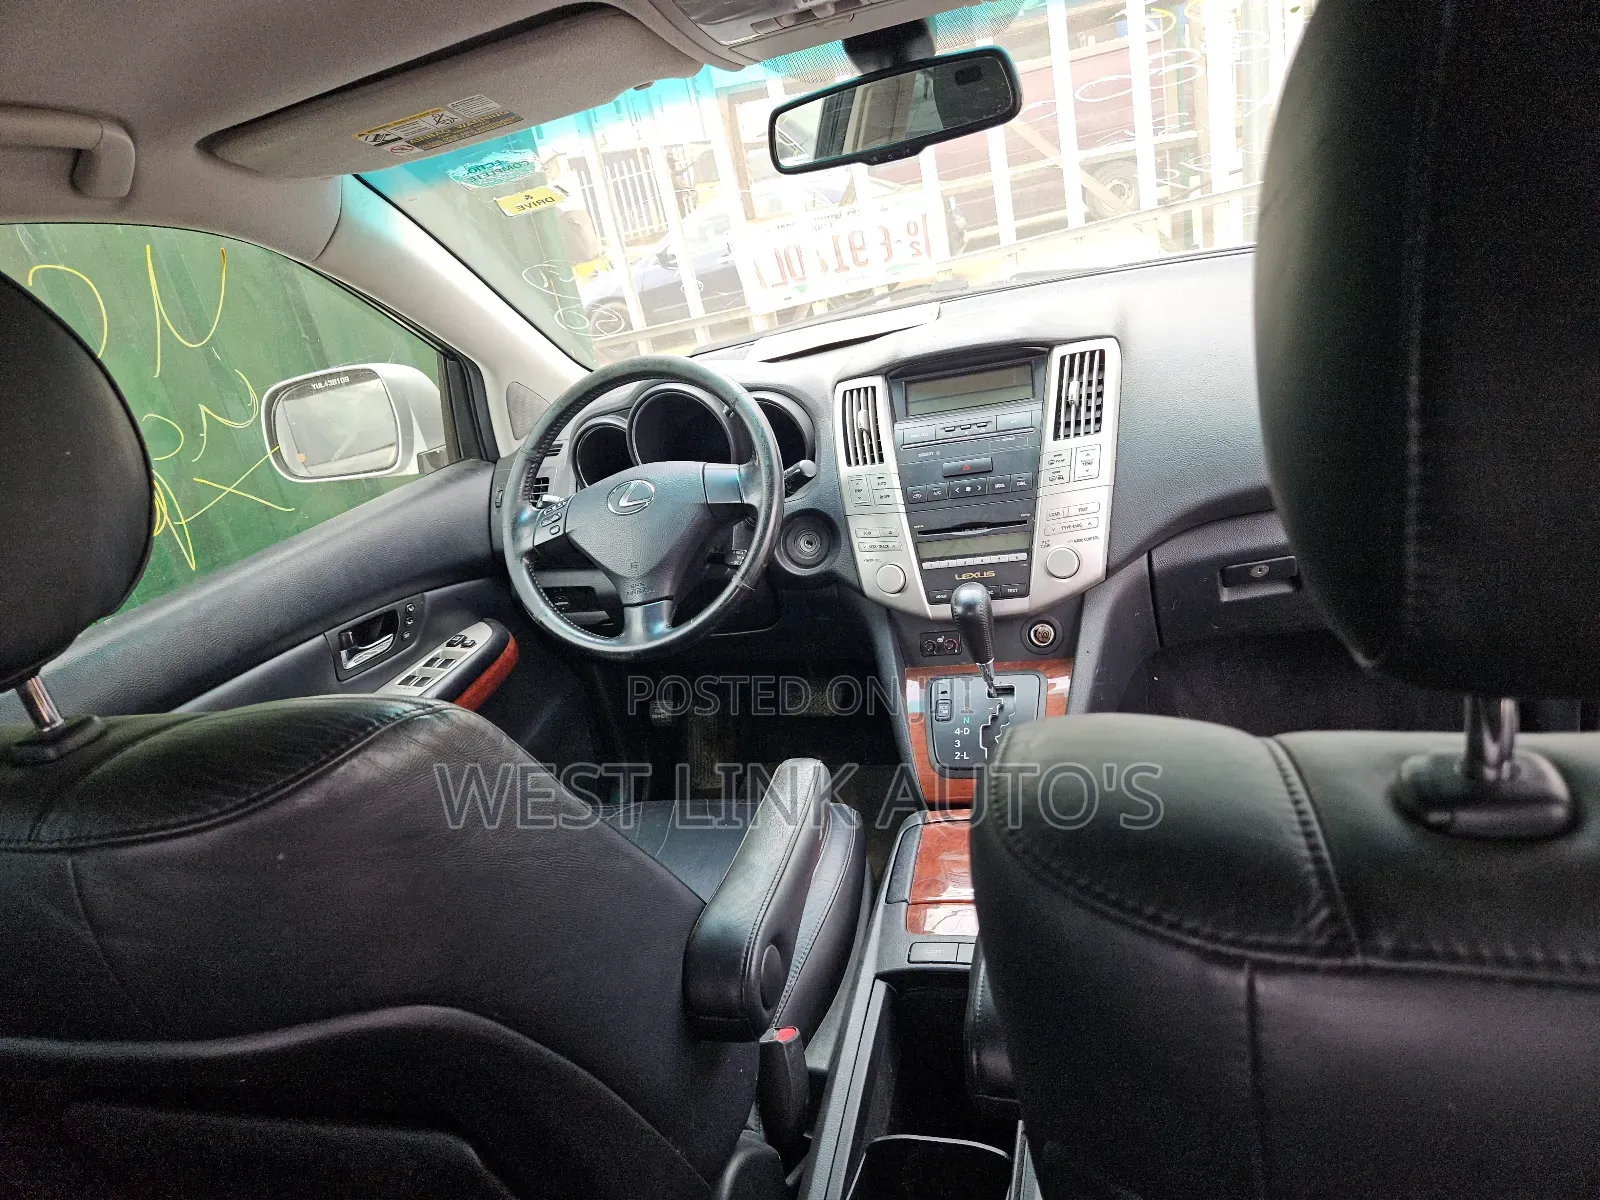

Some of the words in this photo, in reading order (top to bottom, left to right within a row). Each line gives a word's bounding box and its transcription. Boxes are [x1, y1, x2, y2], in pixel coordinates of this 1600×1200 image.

[955, 570, 996, 580] LEXUS
[963, 716, 970, 724] N
[954, 740, 961, 748] 3
[954, 752, 970, 760] 2-L
